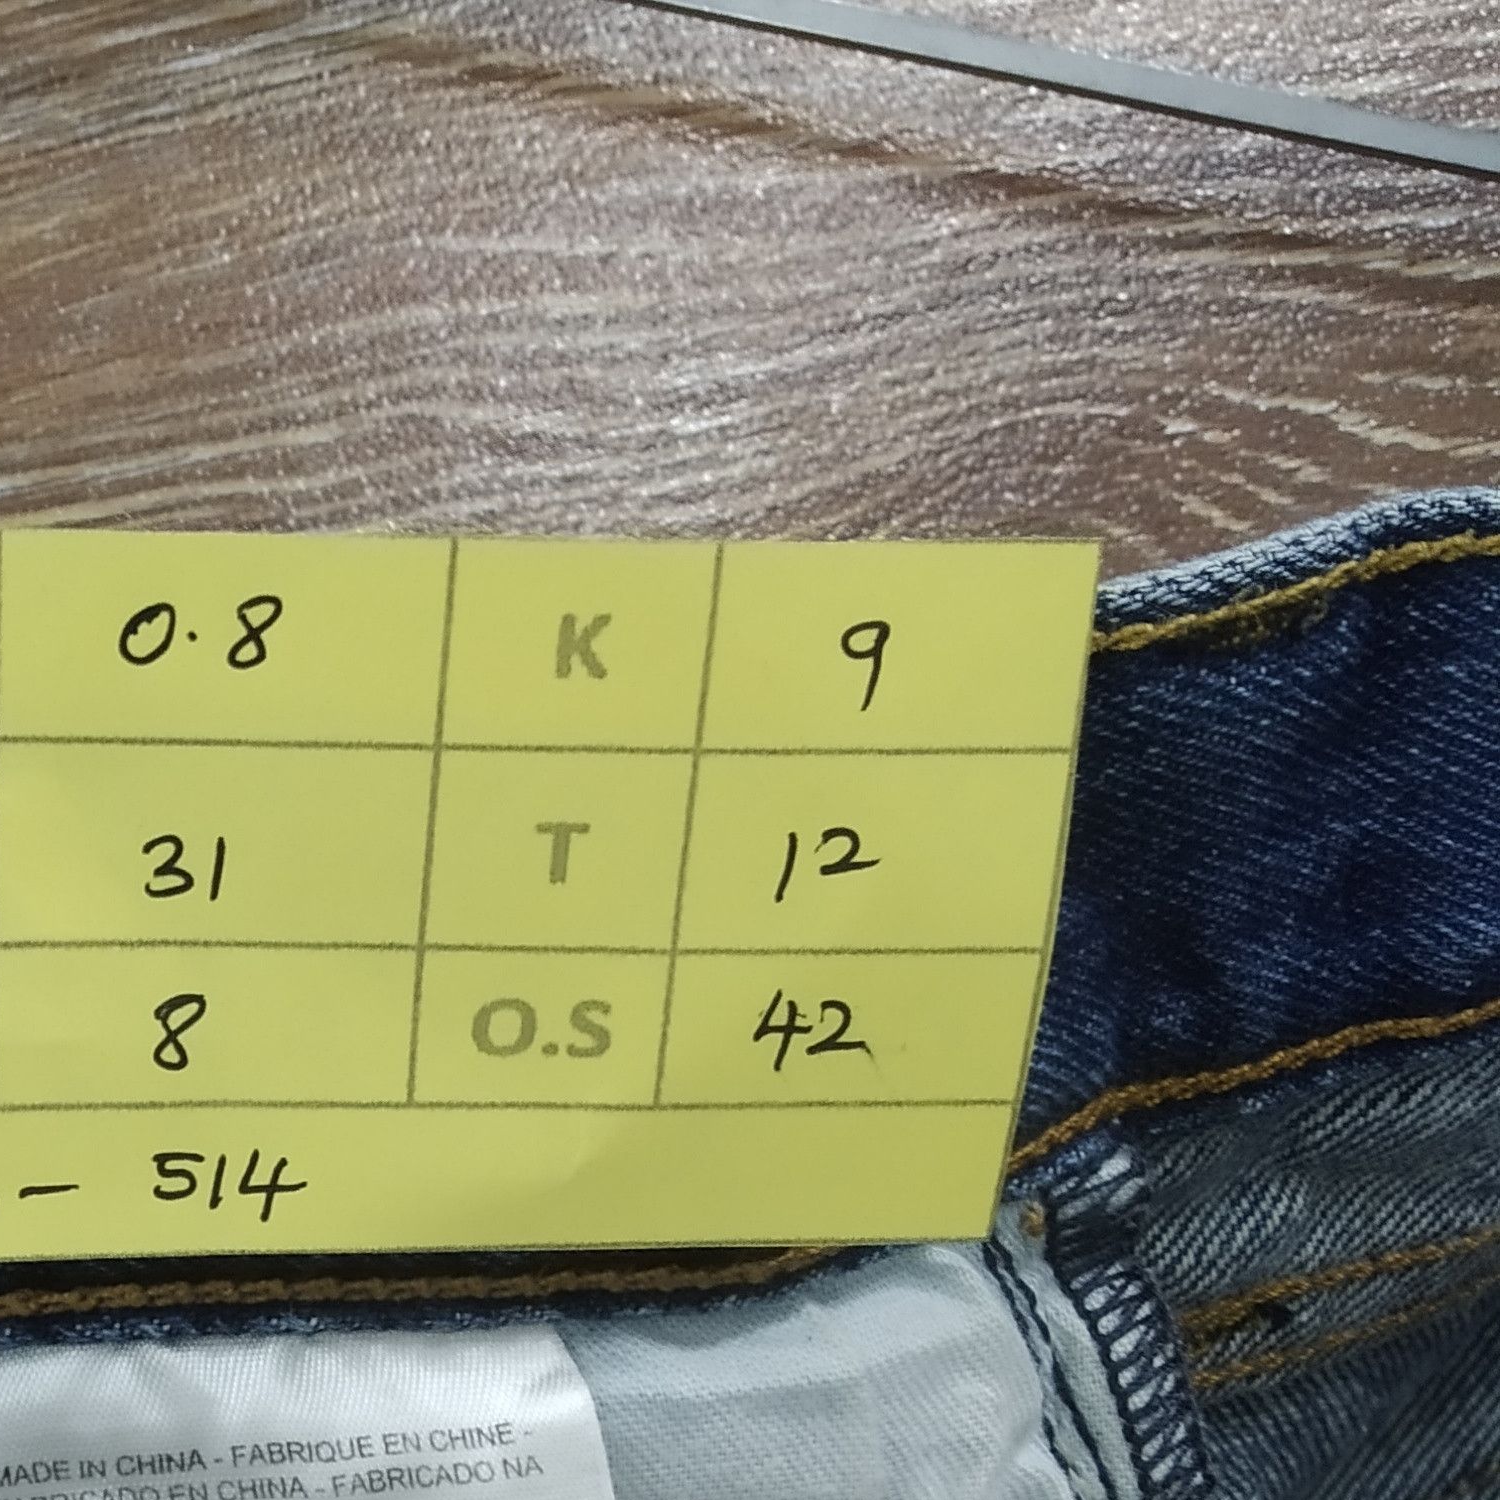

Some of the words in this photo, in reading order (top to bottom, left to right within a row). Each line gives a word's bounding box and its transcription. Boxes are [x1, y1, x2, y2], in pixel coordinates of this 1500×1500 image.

[118, 595, 284, 669] 0.8
[555, 612, 611, 681] K
[840, 619, 891, 711] 9
[142, 834, 228, 901] 31
[536, 821, 590, 884] T
[774, 826, 881, 903] 12
[152, 992, 208, 1071] 8
[471, 997, 613, 1059] O.S
[752, 988, 874, 1072] 42
[150, 1149, 308, 1221] 514
[79, 1459, 107, 1480] IN
[115, 1448, 209, 1477] CHINA
[230, 1435, 375, 1468] FABRIQUE
[382, 1431, 422, 1457] EN
[429, 1421, 516, 1453] CHINE
[331, 1459, 496, 1499] FABRICADO
[501, 1453, 545, 1481] NA
